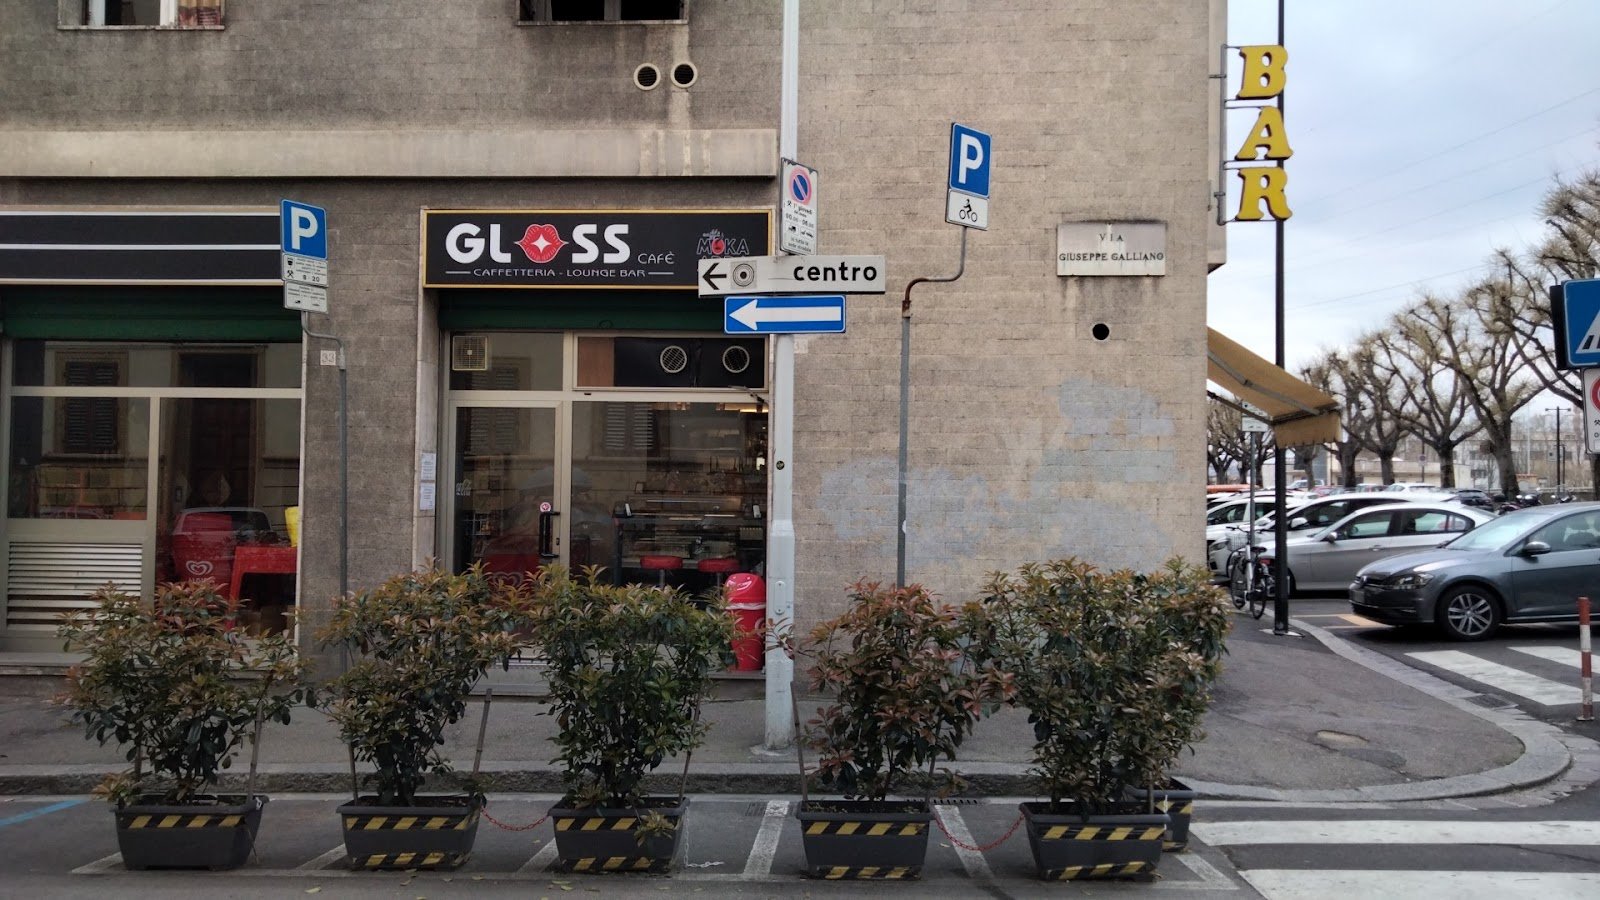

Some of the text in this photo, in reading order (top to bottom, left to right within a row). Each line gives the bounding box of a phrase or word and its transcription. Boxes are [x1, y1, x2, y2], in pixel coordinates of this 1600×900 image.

[1235, 45, 1294, 221] BAR
[958, 133, 984, 185] P
[290, 206, 318, 250] P
[1099, 233, 1124, 242] VIA
[696, 237, 750, 255] MOKA
[1059, 252, 1164, 261] GIUSEPPE GALLIANO
[473, 268, 556, 277] CAFFETTERIA
[566, 268, 616, 277] LOUNGE
[620, 268, 646, 277] BAR
[793, 261, 877, 281] centro
